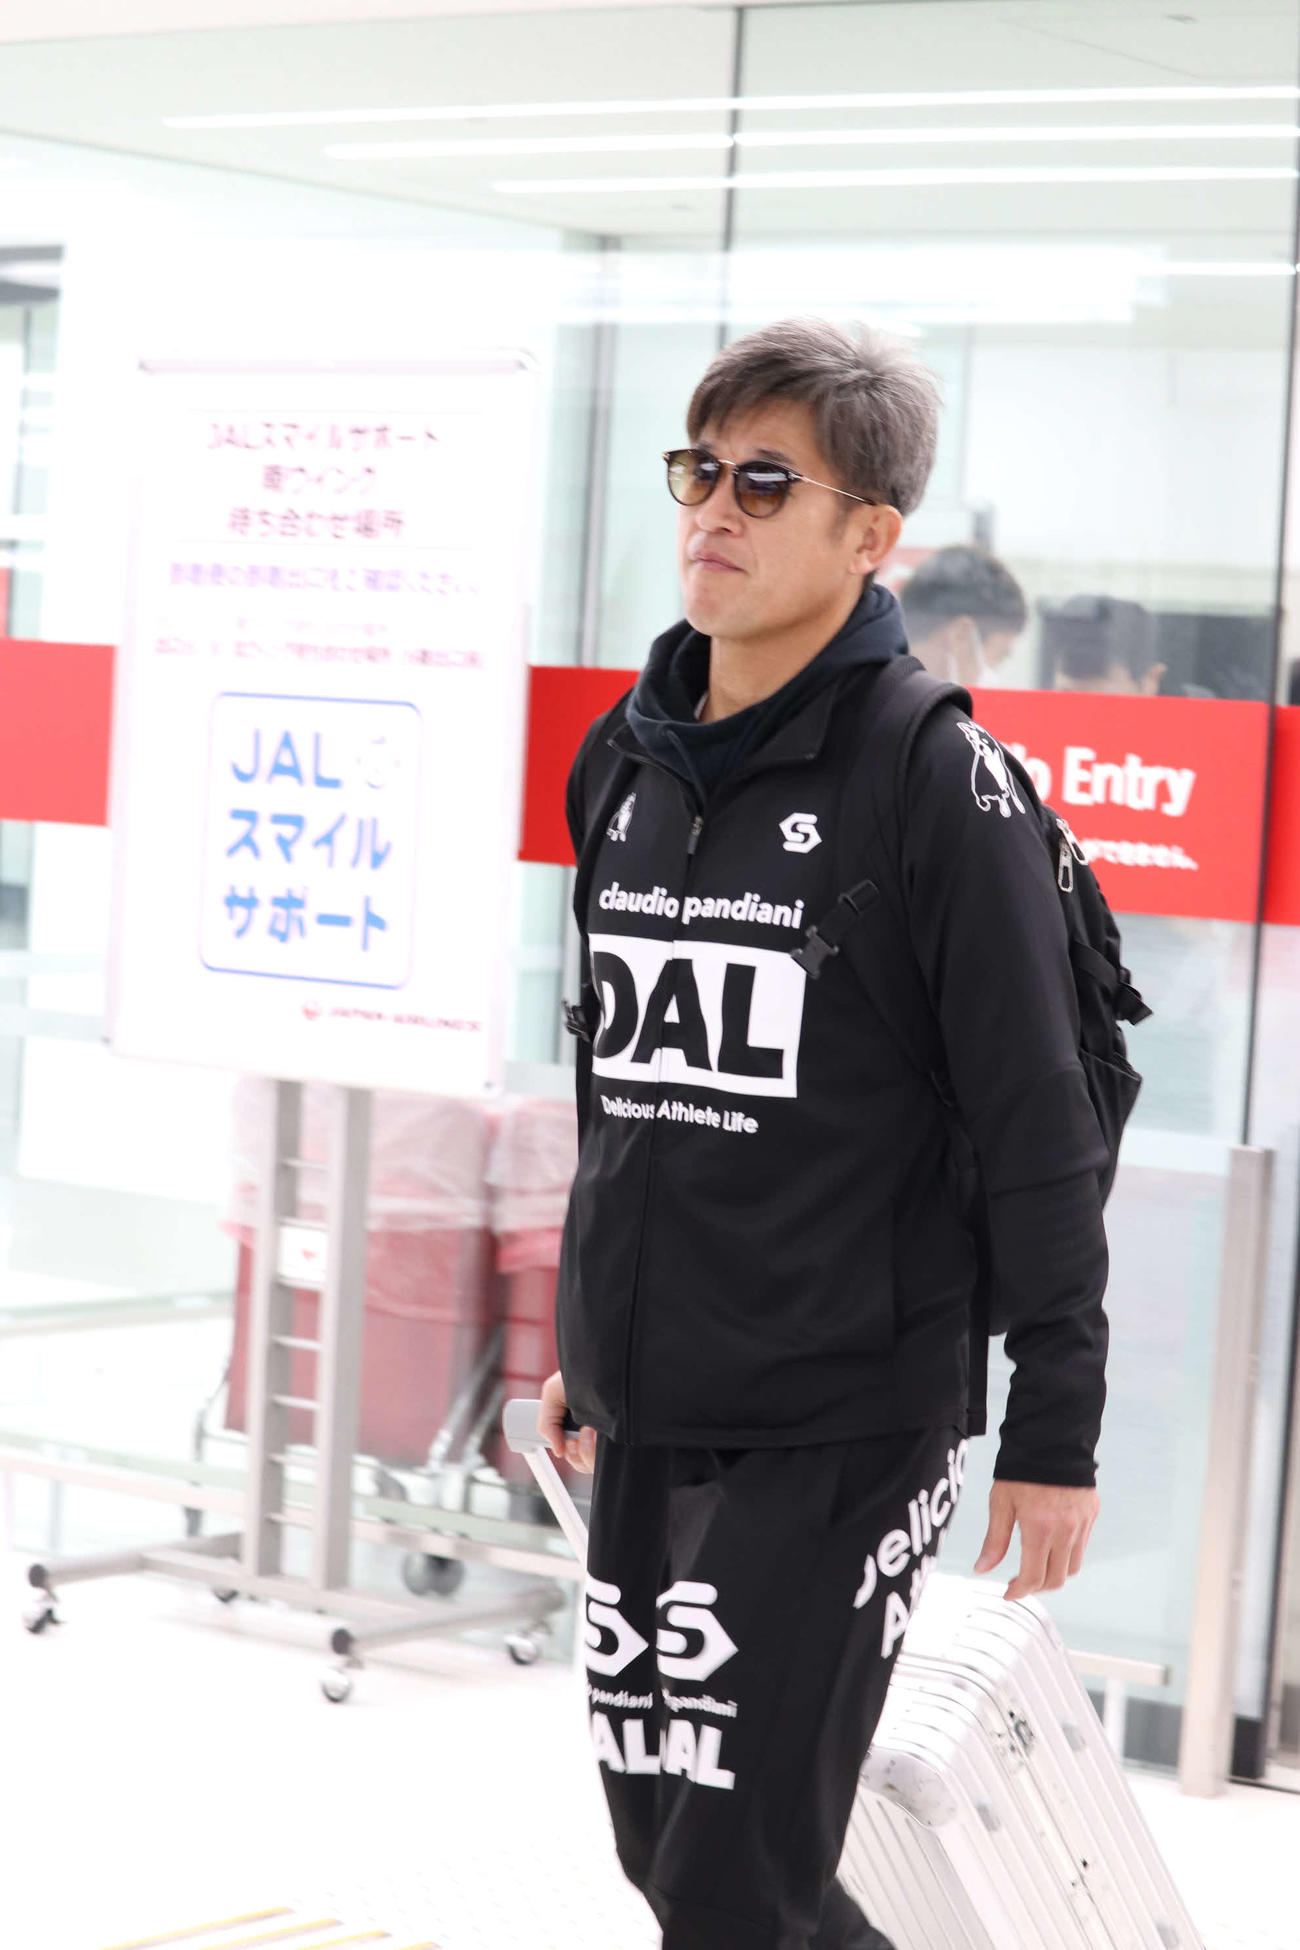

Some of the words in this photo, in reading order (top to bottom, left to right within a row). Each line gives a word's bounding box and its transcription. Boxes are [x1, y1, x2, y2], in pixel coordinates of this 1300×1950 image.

[230, 728, 343, 790] JAL
[1062, 745, 1197, 817] Entry
[225, 807, 393, 870] スマイル
[598, 882, 680, 919] claudio
[681, 891, 805, 929] pandiani
[590, 950, 786, 1080] DAL
[656, 1099, 722, 1129] Athlete
[722, 1110, 760, 1134] Life
[591, 1711, 661, 1775] AL
[660, 1718, 736, 1790] AL
